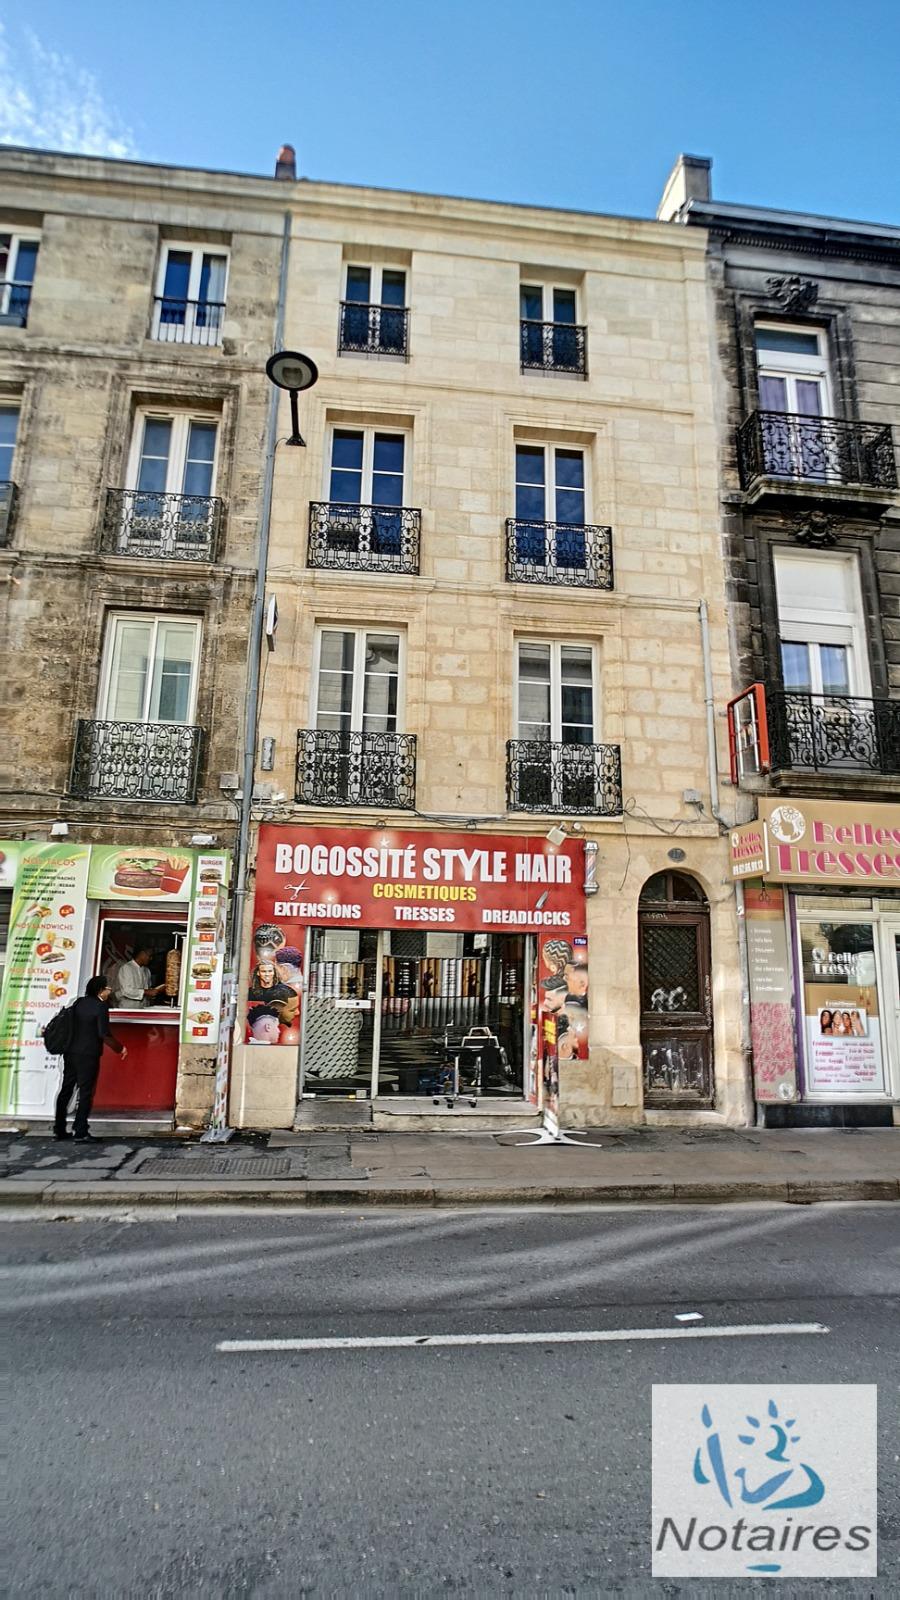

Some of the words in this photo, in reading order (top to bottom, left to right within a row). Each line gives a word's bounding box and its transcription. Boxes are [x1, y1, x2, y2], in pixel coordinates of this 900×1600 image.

[813, 820, 900, 849] Belles
[47, 859, 76, 867] TACOS
[275, 843, 417, 879] BOGOSSITÉ
[423, 847, 507, 882] STYLE
[515, 853, 572, 883] HAIR
[373, 883, 477, 901] COSMETIQUES
[274, 901, 362, 919] EXTENSIONS
[394, 905, 456, 922] TRESSES
[482, 909, 571, 926] DREADLOCKS
[24, 1001, 60, 1009] BOISSONS
